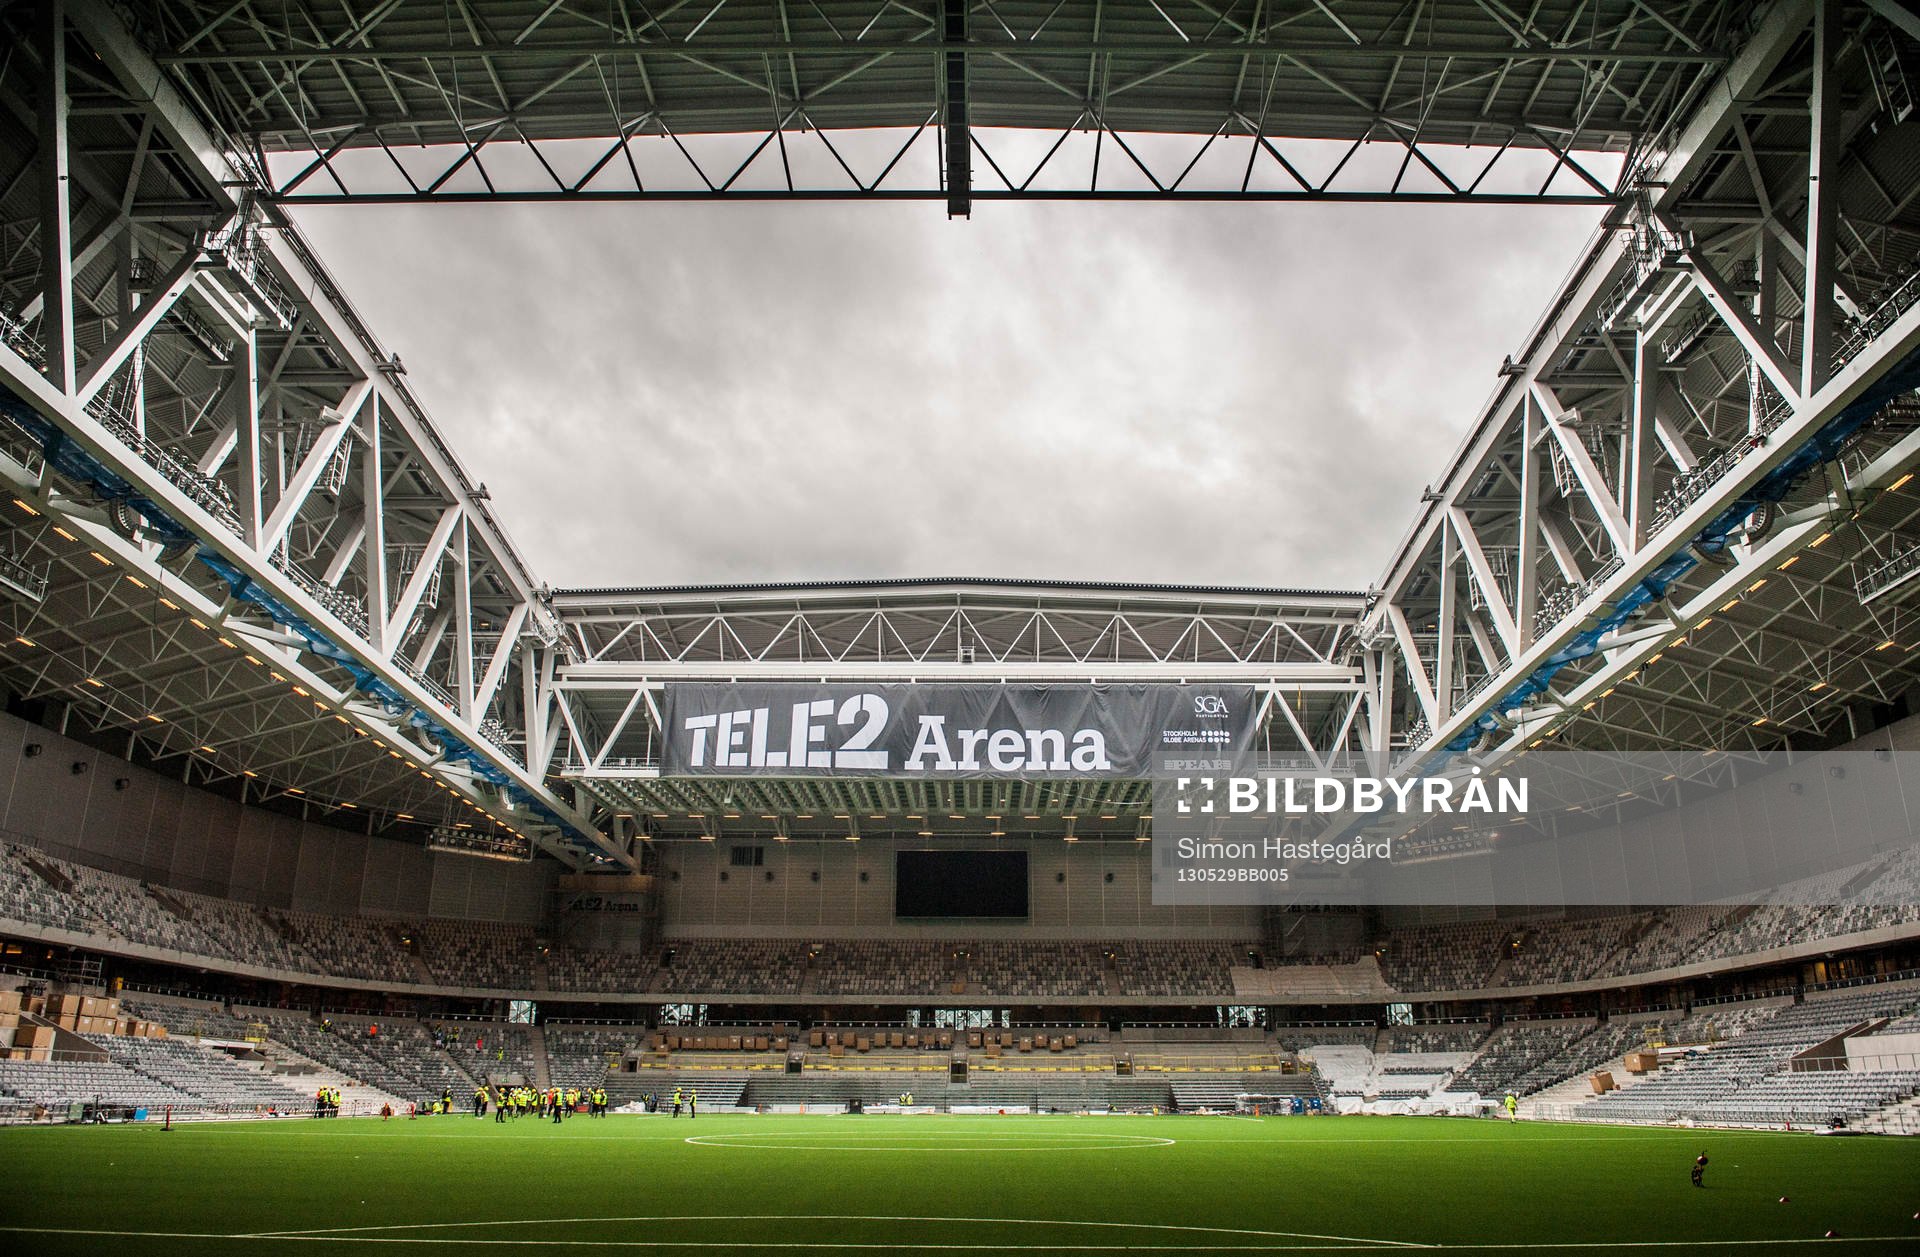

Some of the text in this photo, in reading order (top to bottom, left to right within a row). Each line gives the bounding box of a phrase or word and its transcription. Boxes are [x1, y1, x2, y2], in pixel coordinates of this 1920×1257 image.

[1194, 696, 1229, 713] SGA
[685, 694, 1111, 772] TELE2 Arena
[1172, 760, 1224, 771] PEAB
